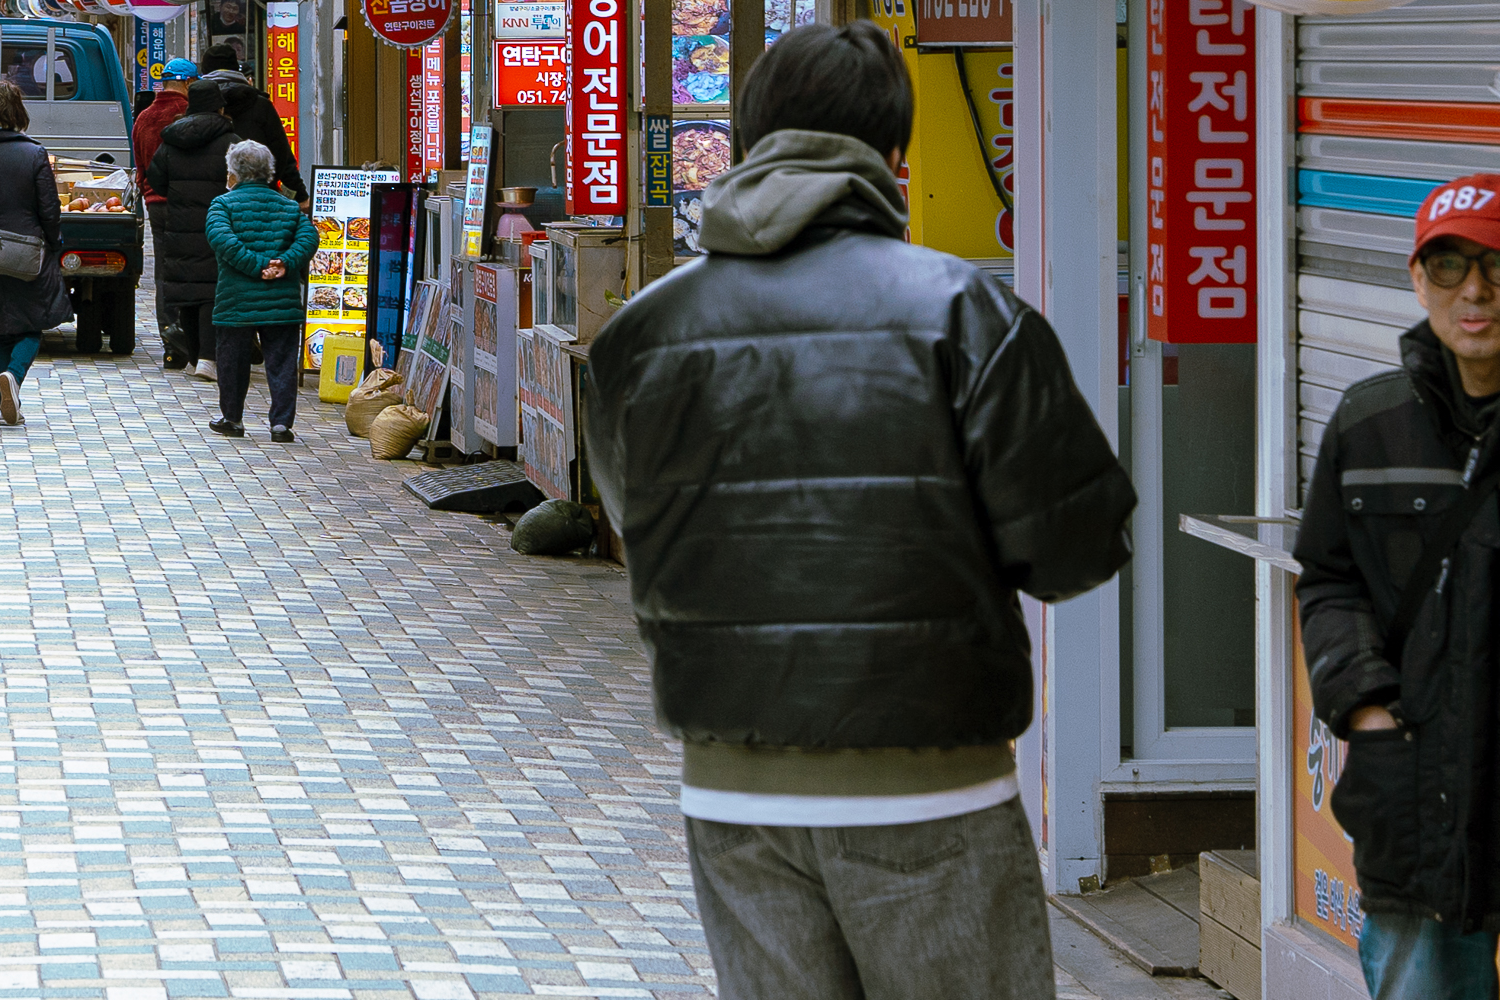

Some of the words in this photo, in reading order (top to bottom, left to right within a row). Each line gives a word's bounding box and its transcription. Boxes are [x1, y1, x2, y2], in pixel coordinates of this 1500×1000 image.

[503, 18, 529, 28] KNN
[153, 27, 163, 61] 해운대
[277, 32, 296, 103] 해운대
[427, 56, 440, 86] 메뉴
[410, 75, 422, 157] 생선구이정식
[427, 90, 441, 162] 포장됩니다
[650, 118, 669, 150] 쌀
[650, 155, 669, 204] 잡곡
[1429, 185, 1496, 221] 1987
